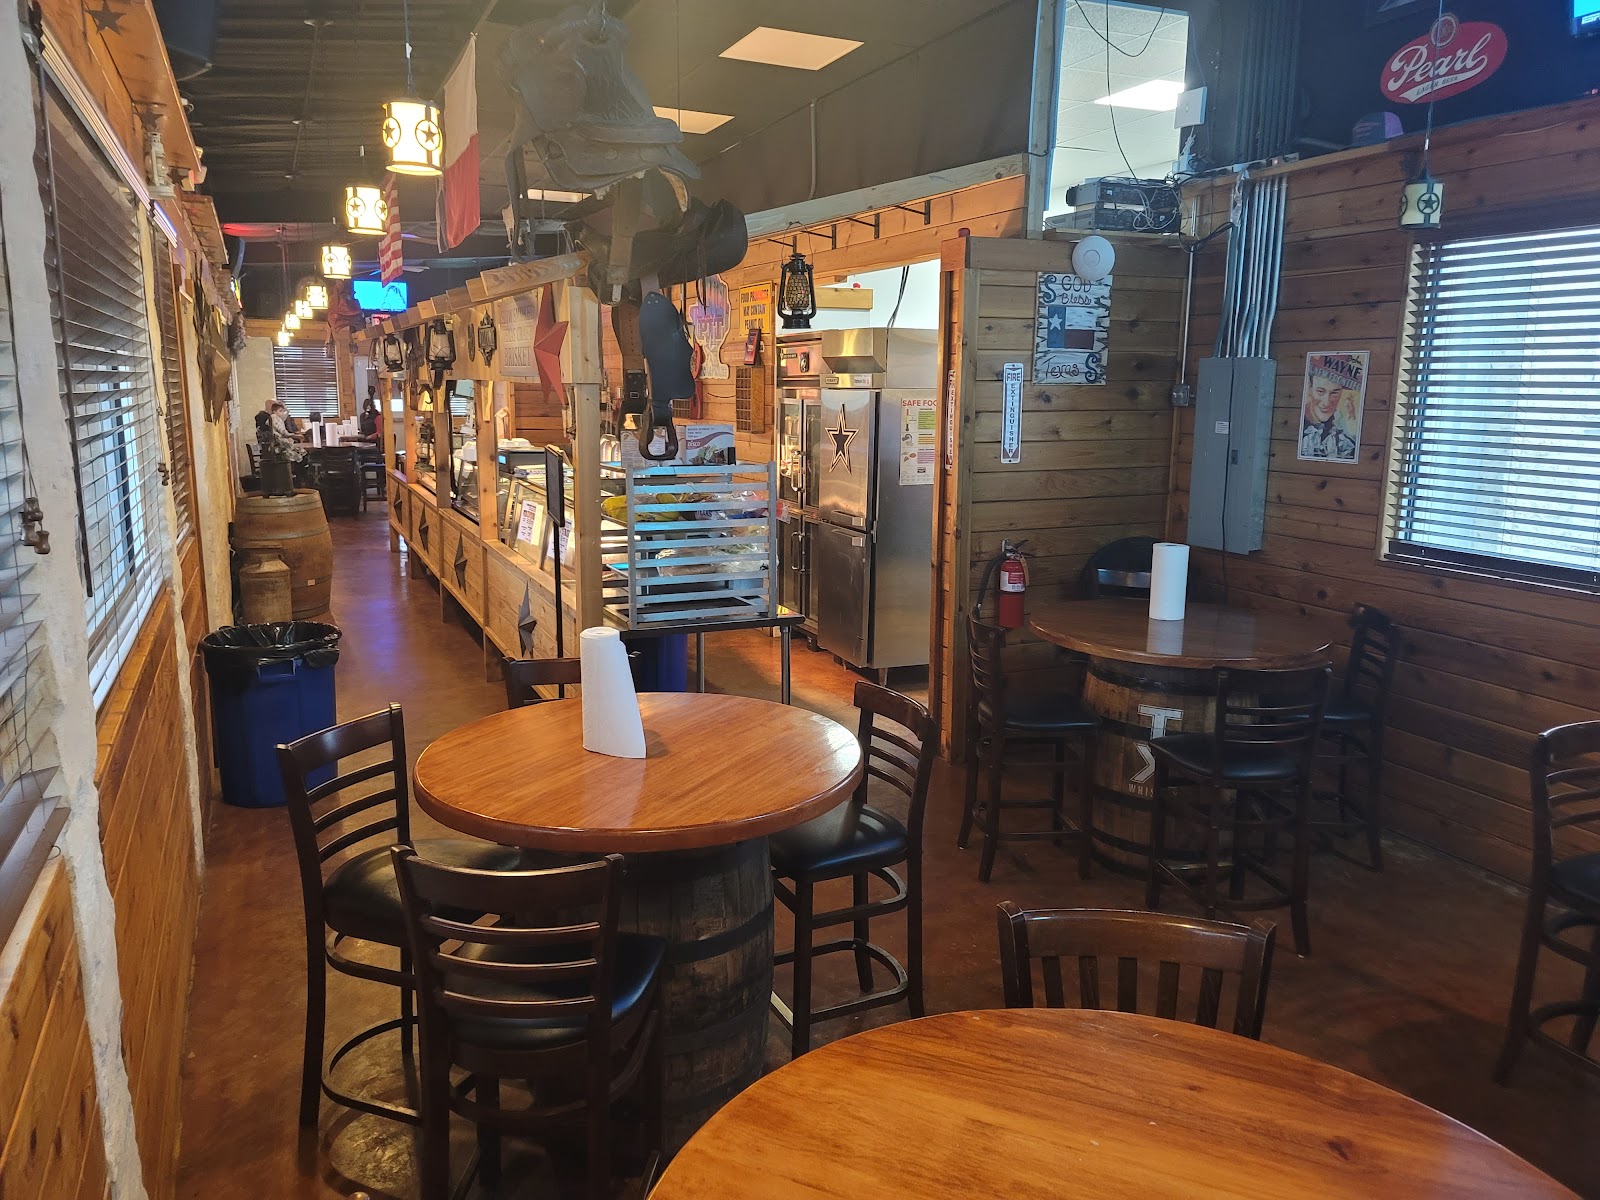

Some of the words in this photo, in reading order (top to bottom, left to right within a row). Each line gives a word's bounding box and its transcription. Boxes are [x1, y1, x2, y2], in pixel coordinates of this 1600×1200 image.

[1387, 32, 1492, 92] Pearl
[504, 346, 532, 368] BRISKET
[1042, 355, 1080, 379] Texas
[1324, 355, 1363, 381] WAYNE
[1006, 372, 1021, 382] FIRE
[902, 399, 922, 407] SAFE
[1008, 383, 1016, 455] EXTINGUISHER
